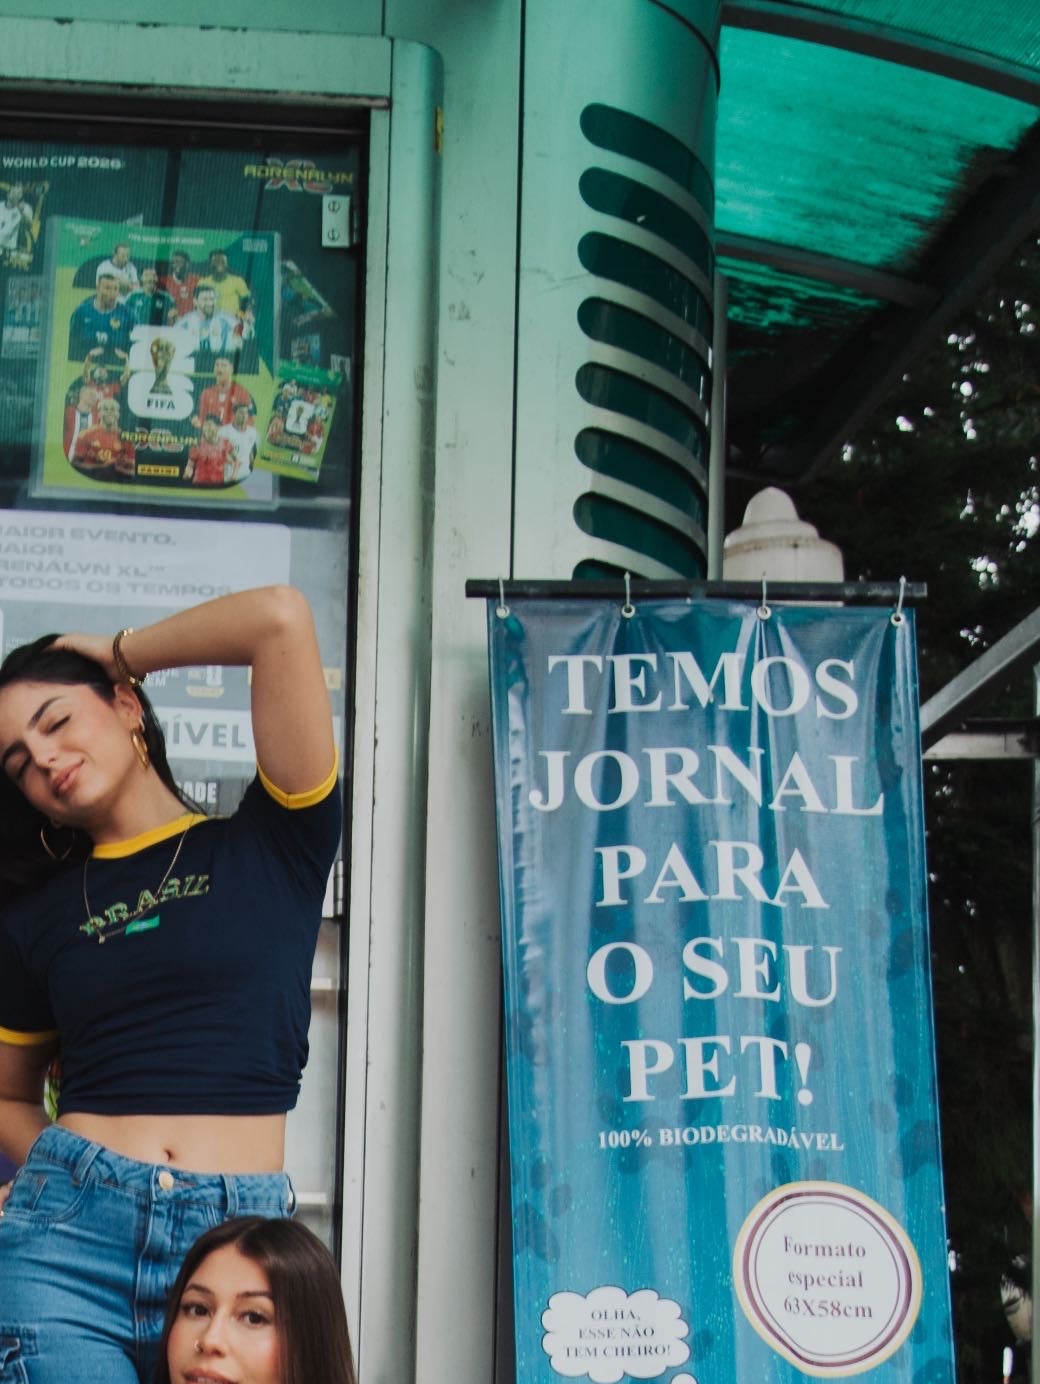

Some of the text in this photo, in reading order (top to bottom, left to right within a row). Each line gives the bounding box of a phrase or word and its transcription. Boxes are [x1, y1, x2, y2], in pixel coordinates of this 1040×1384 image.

[2, 156, 48, 168] WORLD
[50, 156, 76, 168] CUP
[146, 399, 176, 410] FIFA
[548, 651, 858, 720] TEMOS
[528, 745, 885, 816] JORNAL
[594, 840, 831, 909] PARA
[587, 936, 842, 1007] O SEU
[620, 1035, 813, 1106] PET!
[598, 1124, 845, 1151] 100% BIODEGRADÁVEL
[784, 1235, 866, 1259] Formato
[788, 1269, 863, 1295] especial
[591, 1309, 641, 1323] OLHA,
[783, 1297, 873, 1319] 63X58cm
[578, 1324, 655, 1339] ESSE NÃO
[564, 1343, 671, 1358] TEM CHEIRO!
